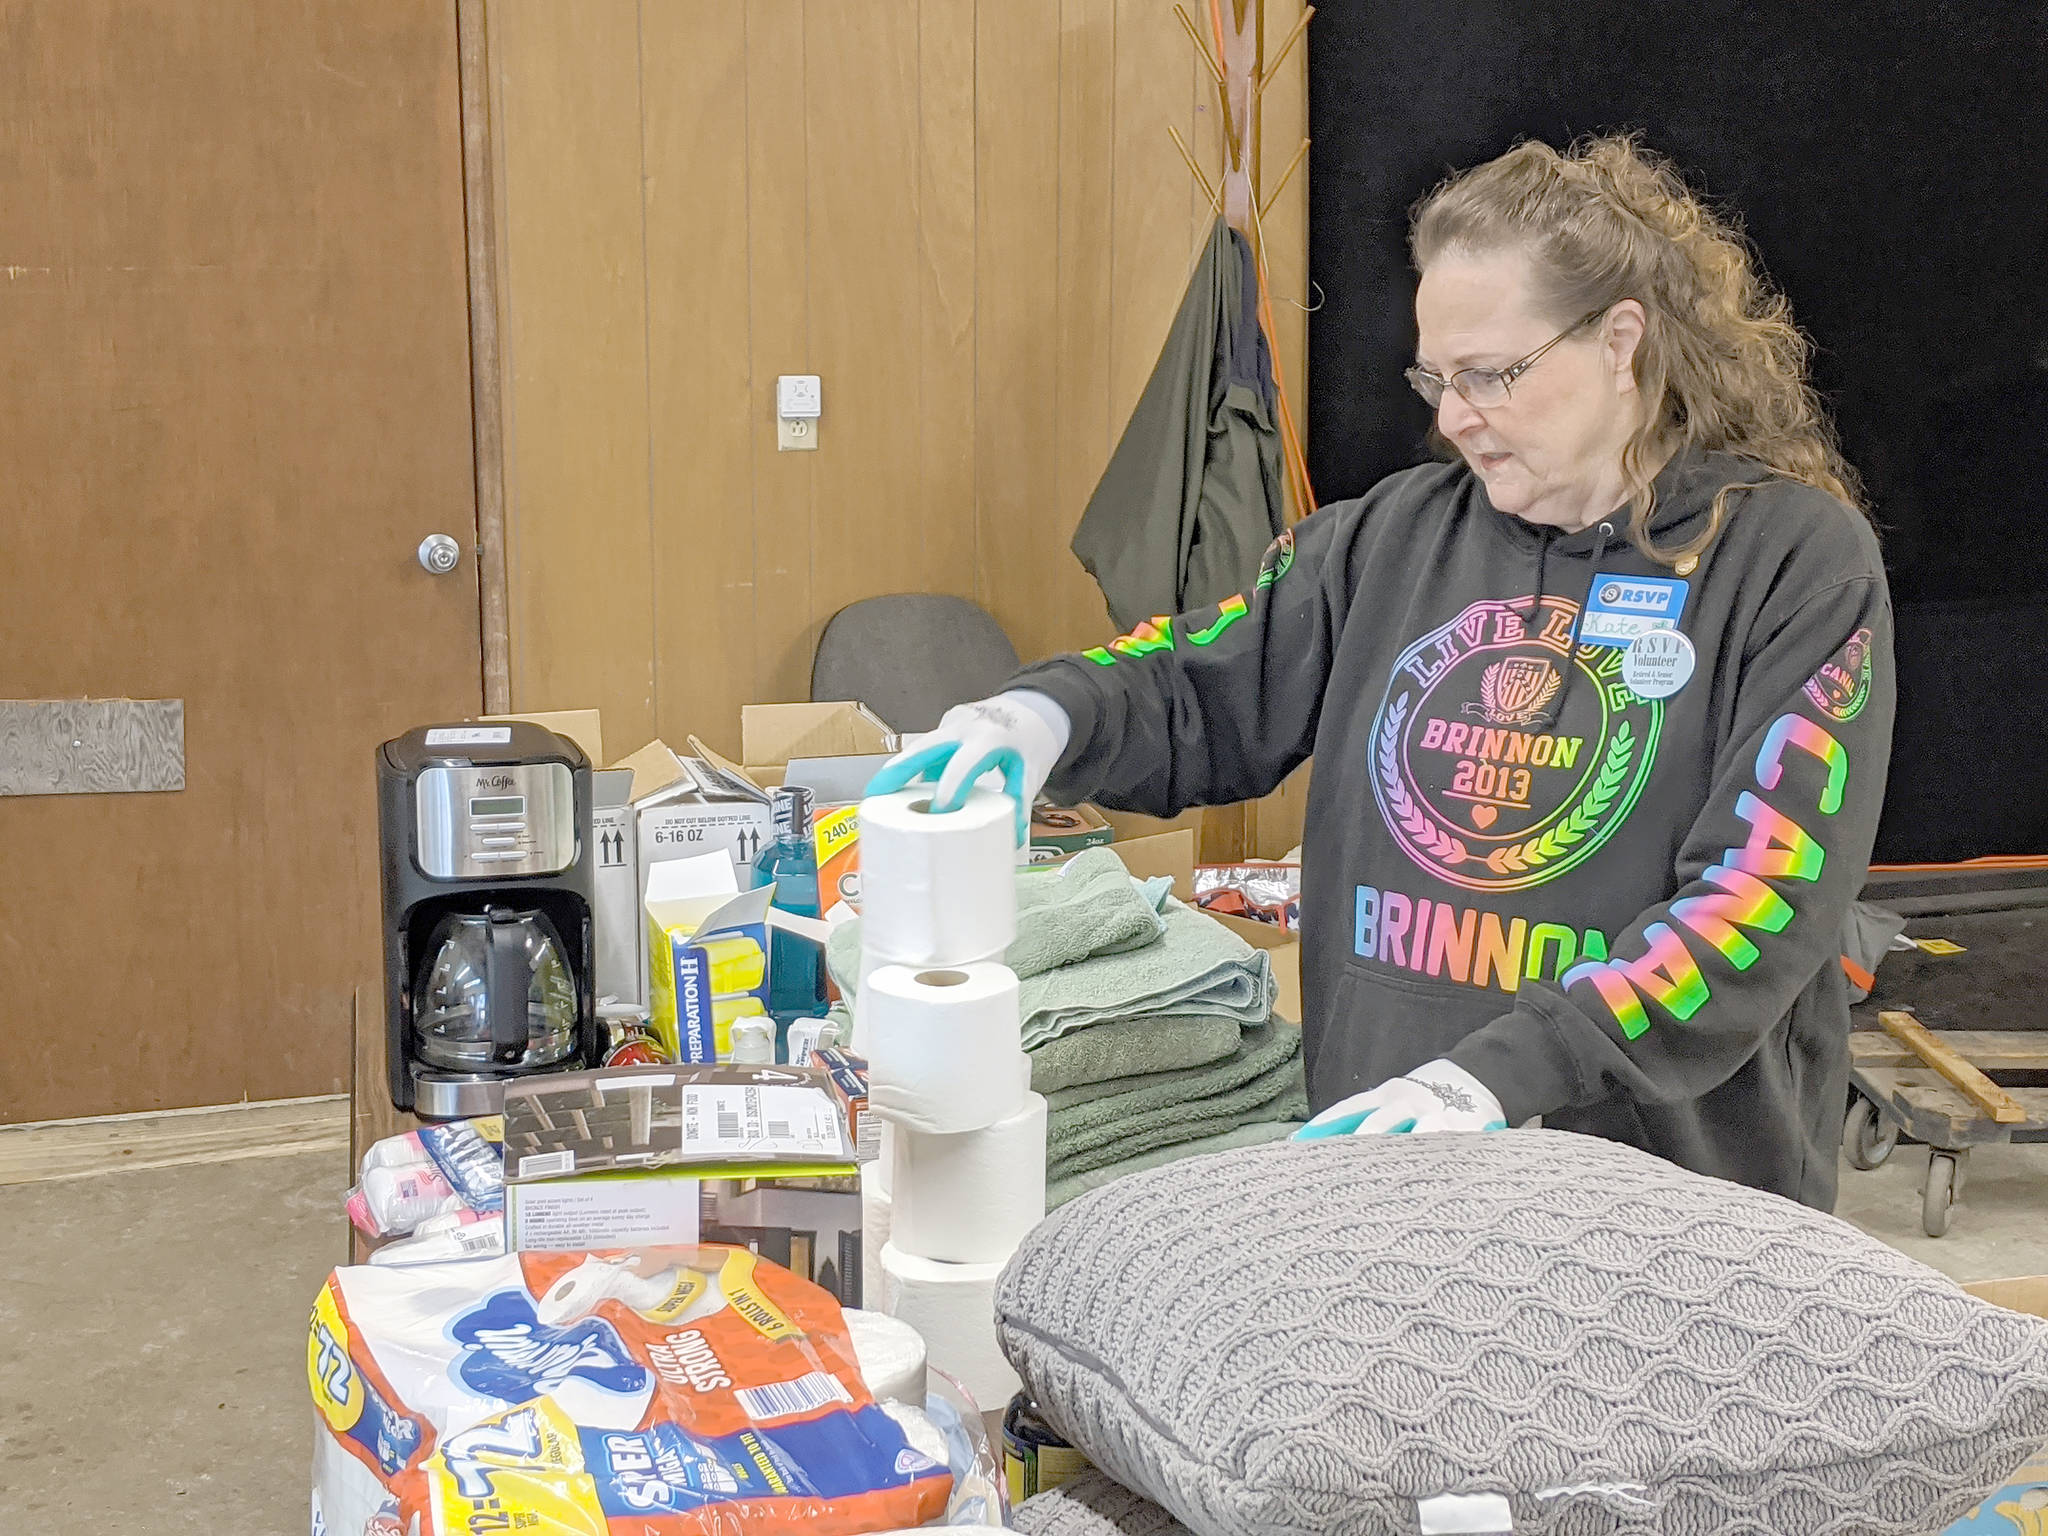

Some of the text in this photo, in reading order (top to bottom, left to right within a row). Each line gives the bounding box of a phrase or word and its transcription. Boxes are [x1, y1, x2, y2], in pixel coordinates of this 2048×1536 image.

[1621, 589, 1669, 604] RSVP
[1584, 613, 1641, 635] Kate
[1404, 608, 1650, 713] LIVE LVE
[1633, 653, 1678, 667] Volunteer
[1419, 718, 1584, 769] BRINNON
[491, 775, 517, 790] Coffee
[1453, 760, 1532, 801] 2013
[698, 816, 716, 824] BELOW
[717, 815, 738, 823] DOTTED
[655, 829, 704, 843] 6-16 OZ
[823, 822, 848, 844] 240
[1561, 712, 1849, 1041] CANAL
[680, 957, 699, 975] H
[733, 1292, 749, 1312] IN
[741, 1301, 777, 1327] ROLLS
[645, 1342, 689, 1385] ULTRA
[664, 1328, 732, 1392] STRONG
